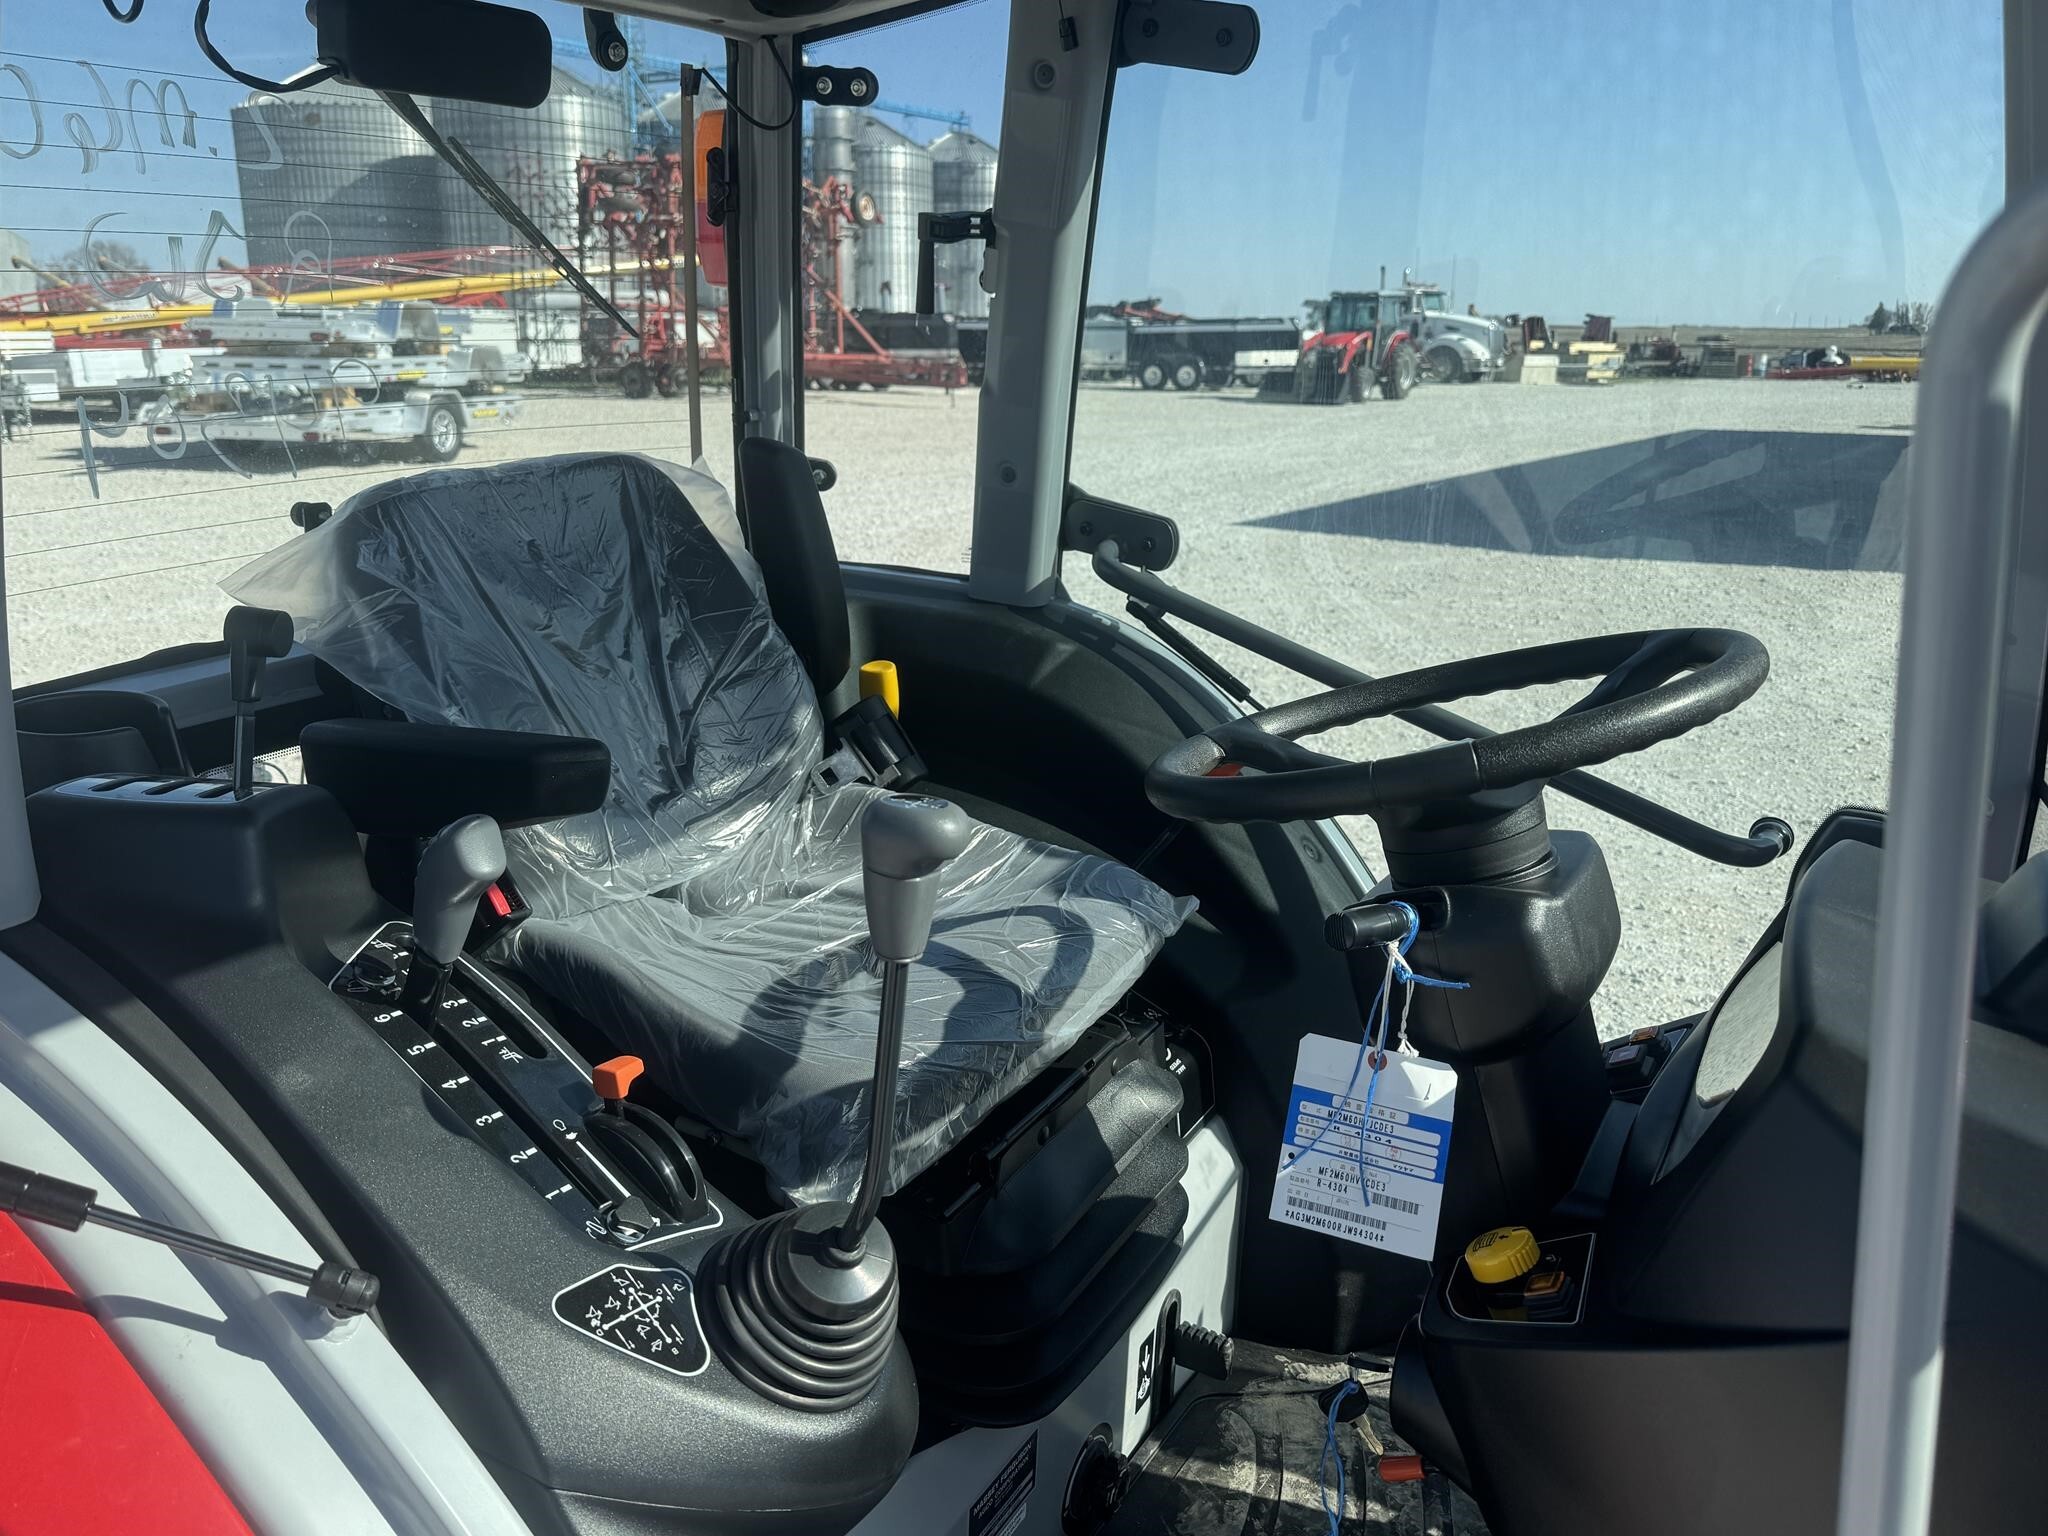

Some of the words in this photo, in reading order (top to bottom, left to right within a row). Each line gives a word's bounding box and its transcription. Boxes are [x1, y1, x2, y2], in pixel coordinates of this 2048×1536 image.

[374, 1013, 391, 1023] 6
[407, 1043, 426, 1056] 5
[441, 1079, 457, 1089] 4
[476, 1114, 493, 1126] 3
[511, 1150, 528, 1163] 2
